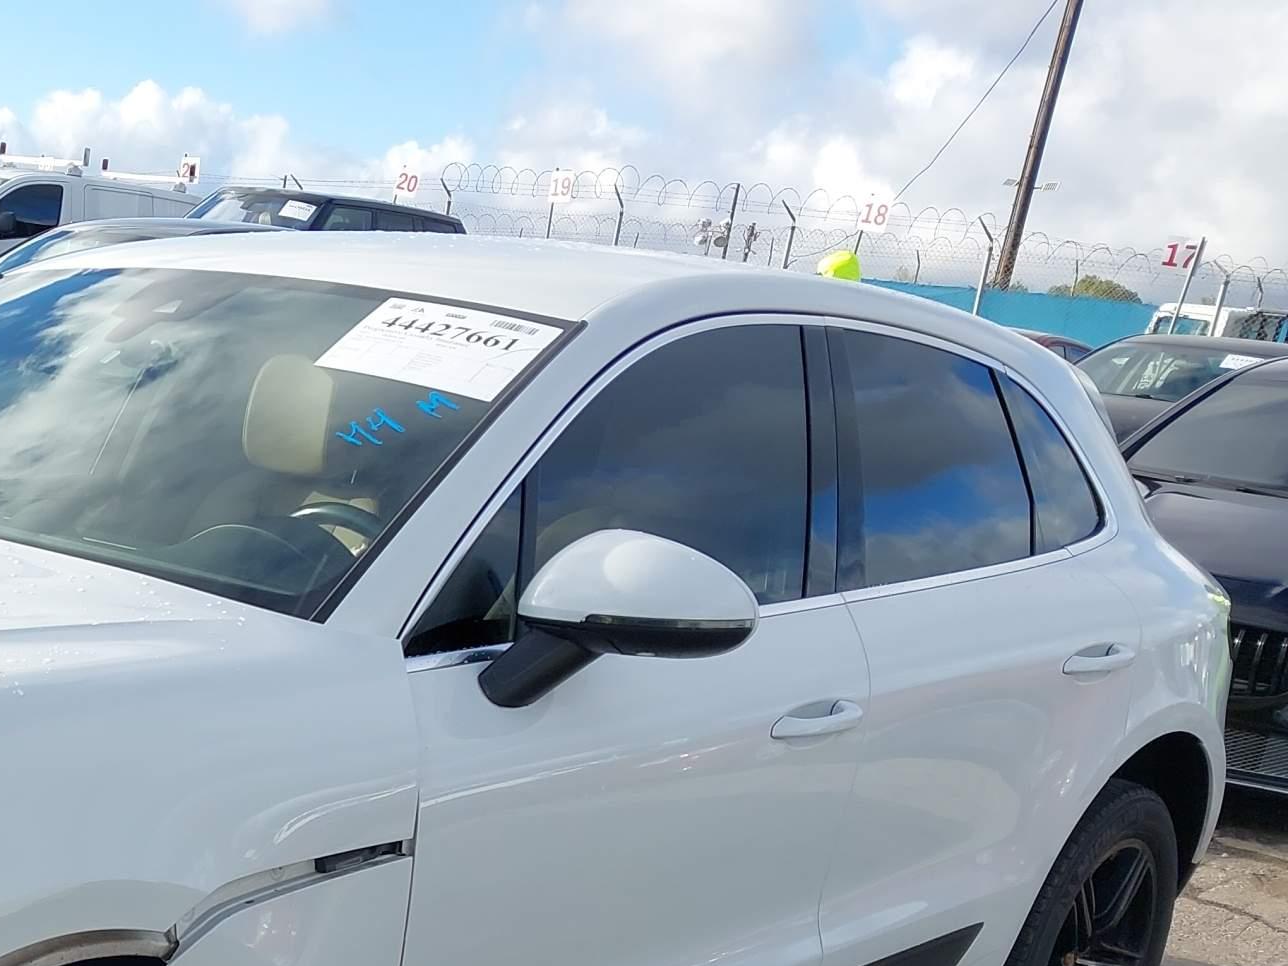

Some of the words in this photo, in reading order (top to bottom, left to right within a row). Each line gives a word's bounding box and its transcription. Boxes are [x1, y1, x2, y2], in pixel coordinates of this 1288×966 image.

[396, 172, 419, 193] 20
[551, 177, 572, 197] 19
[860, 203, 889, 226] 18
[1161, 243, 1198, 269] 17
[380, 314, 521, 351] 44427661
